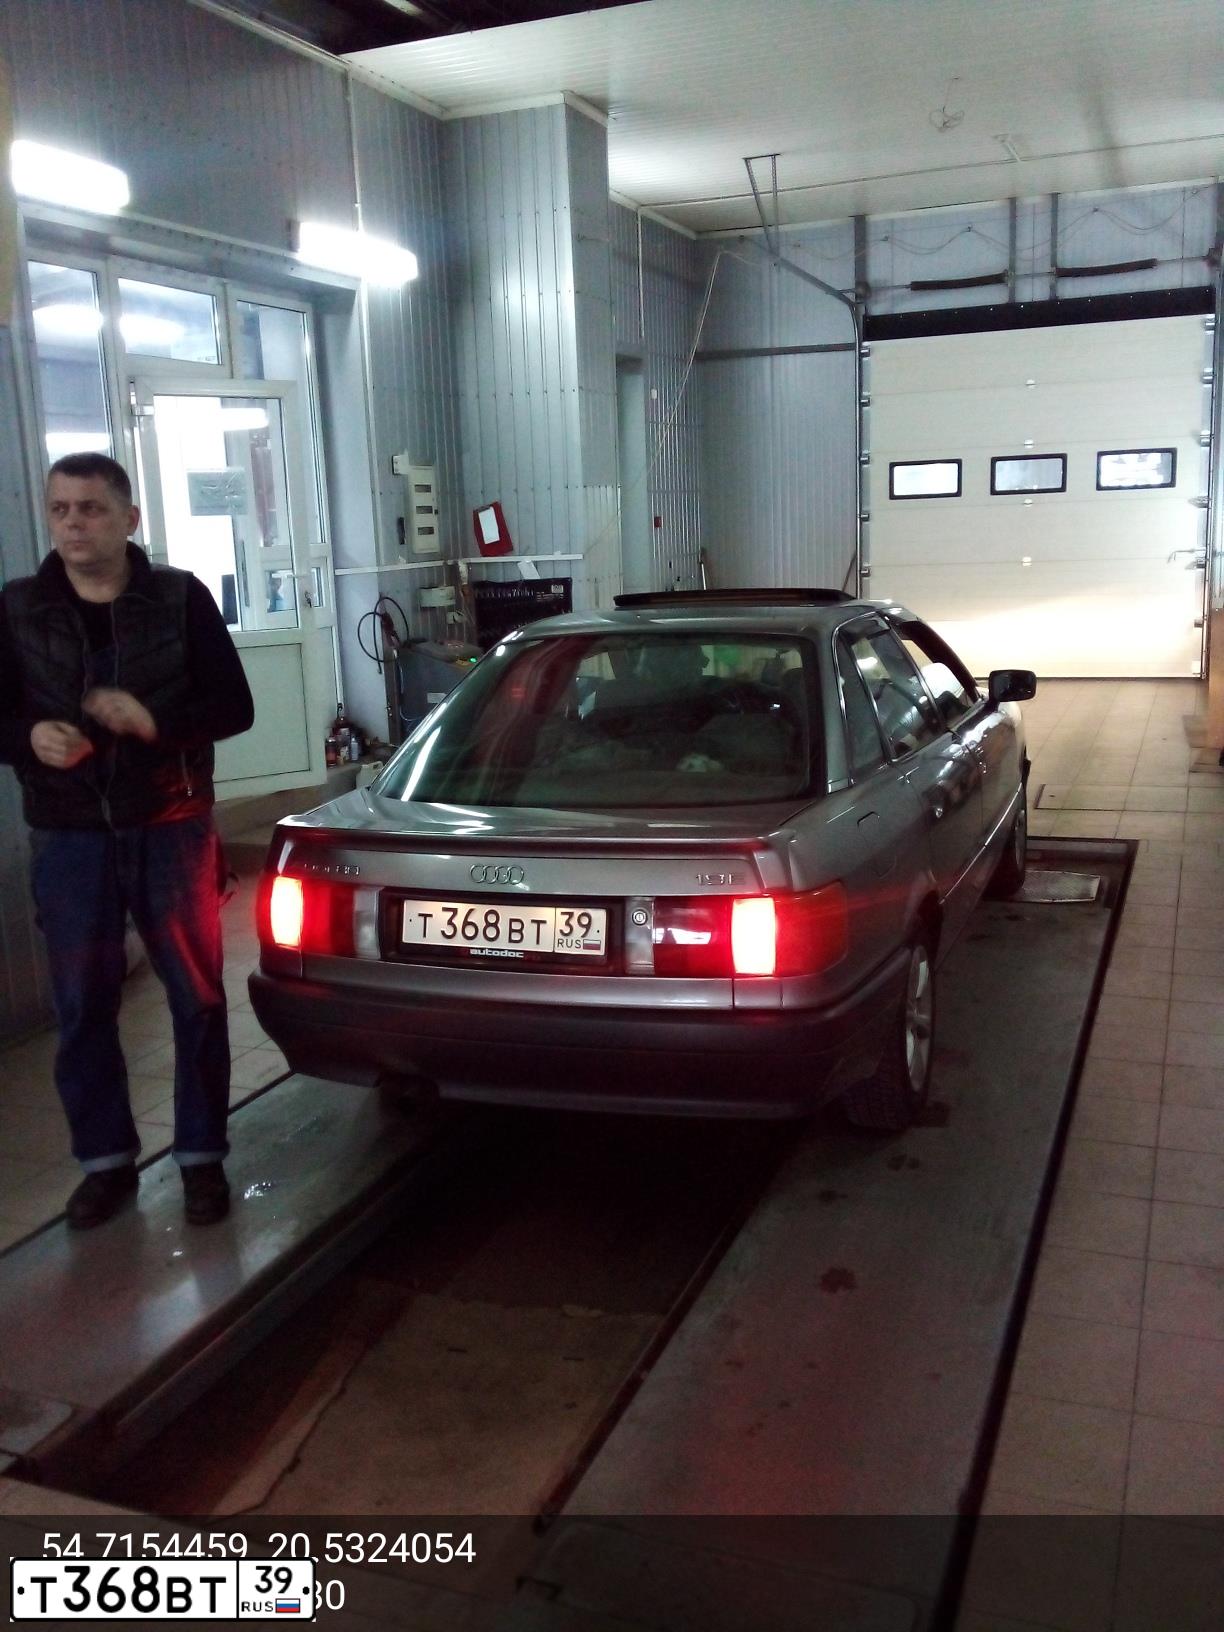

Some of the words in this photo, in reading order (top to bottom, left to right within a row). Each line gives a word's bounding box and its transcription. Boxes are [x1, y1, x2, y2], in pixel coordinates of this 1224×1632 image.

[559, 911, 593, 938] 39
[557, 938, 582, 949] RUS
[469, 948, 525, 958] autodoc
